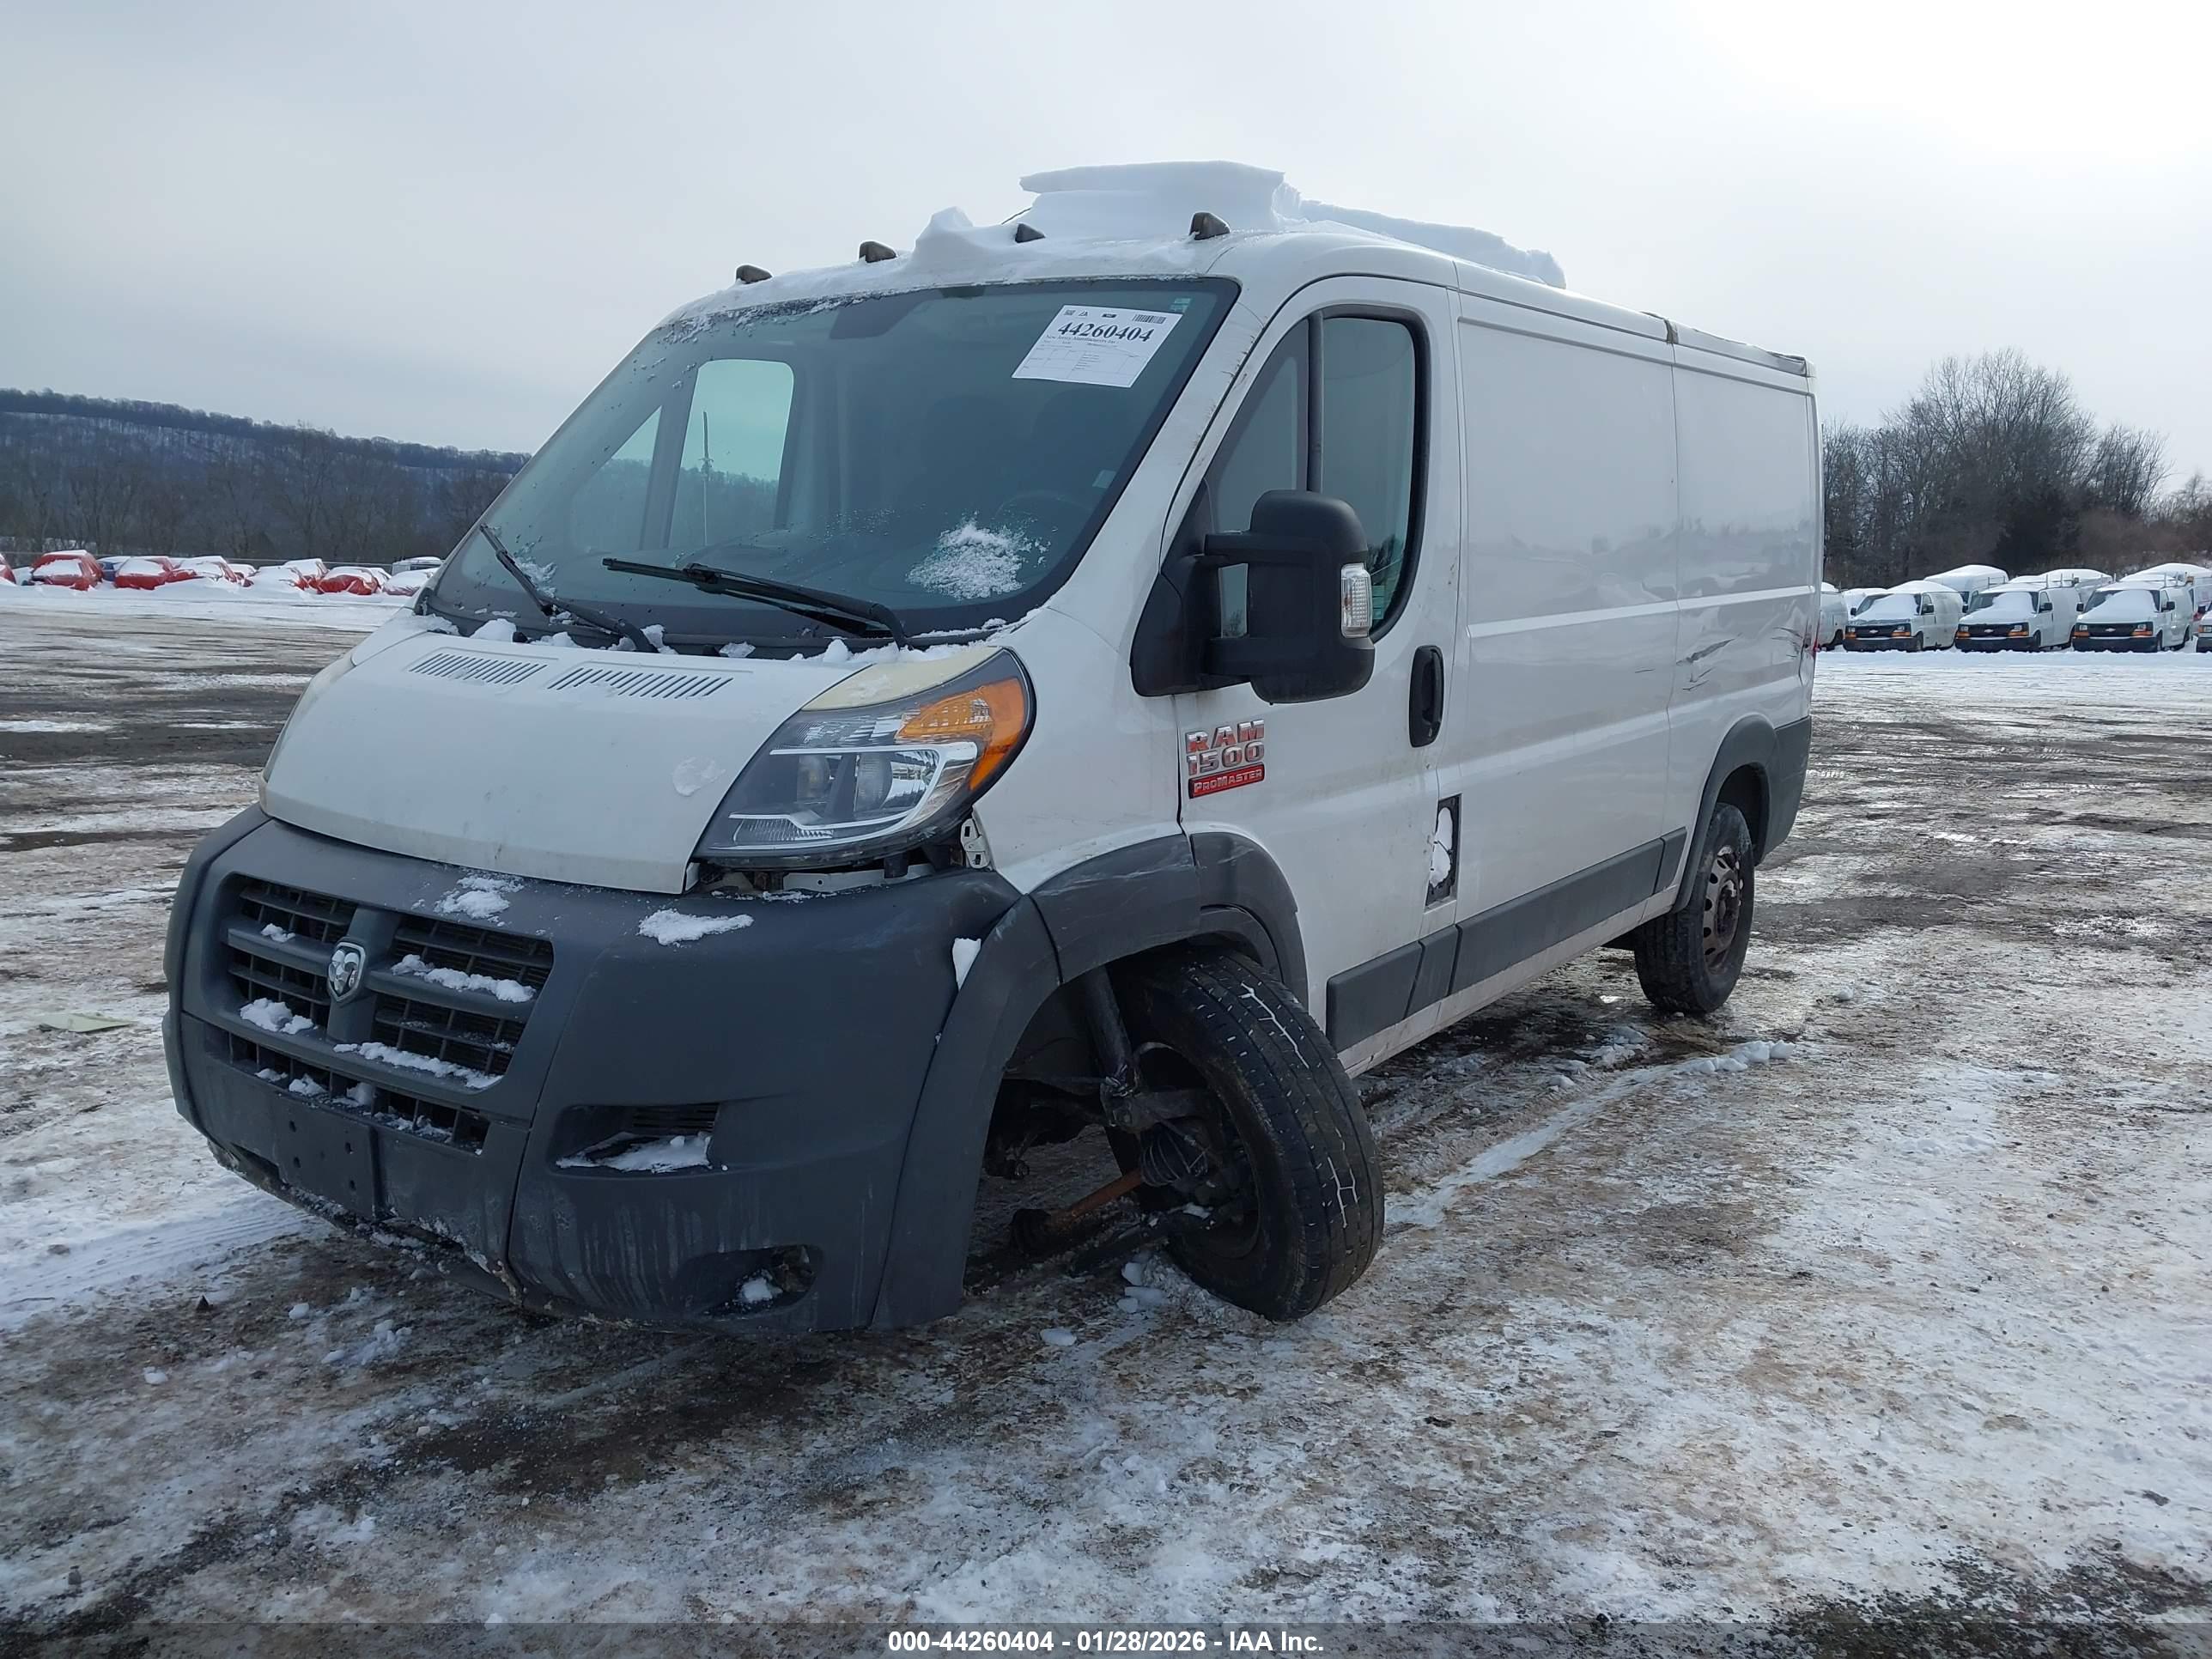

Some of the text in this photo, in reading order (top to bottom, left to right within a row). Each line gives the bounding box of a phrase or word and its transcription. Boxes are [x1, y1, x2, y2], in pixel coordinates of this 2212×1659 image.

[1058, 321, 1155, 342] 44260404
[1185, 720, 1264, 754] RAM
[1187, 741, 1264, 776] 1500
